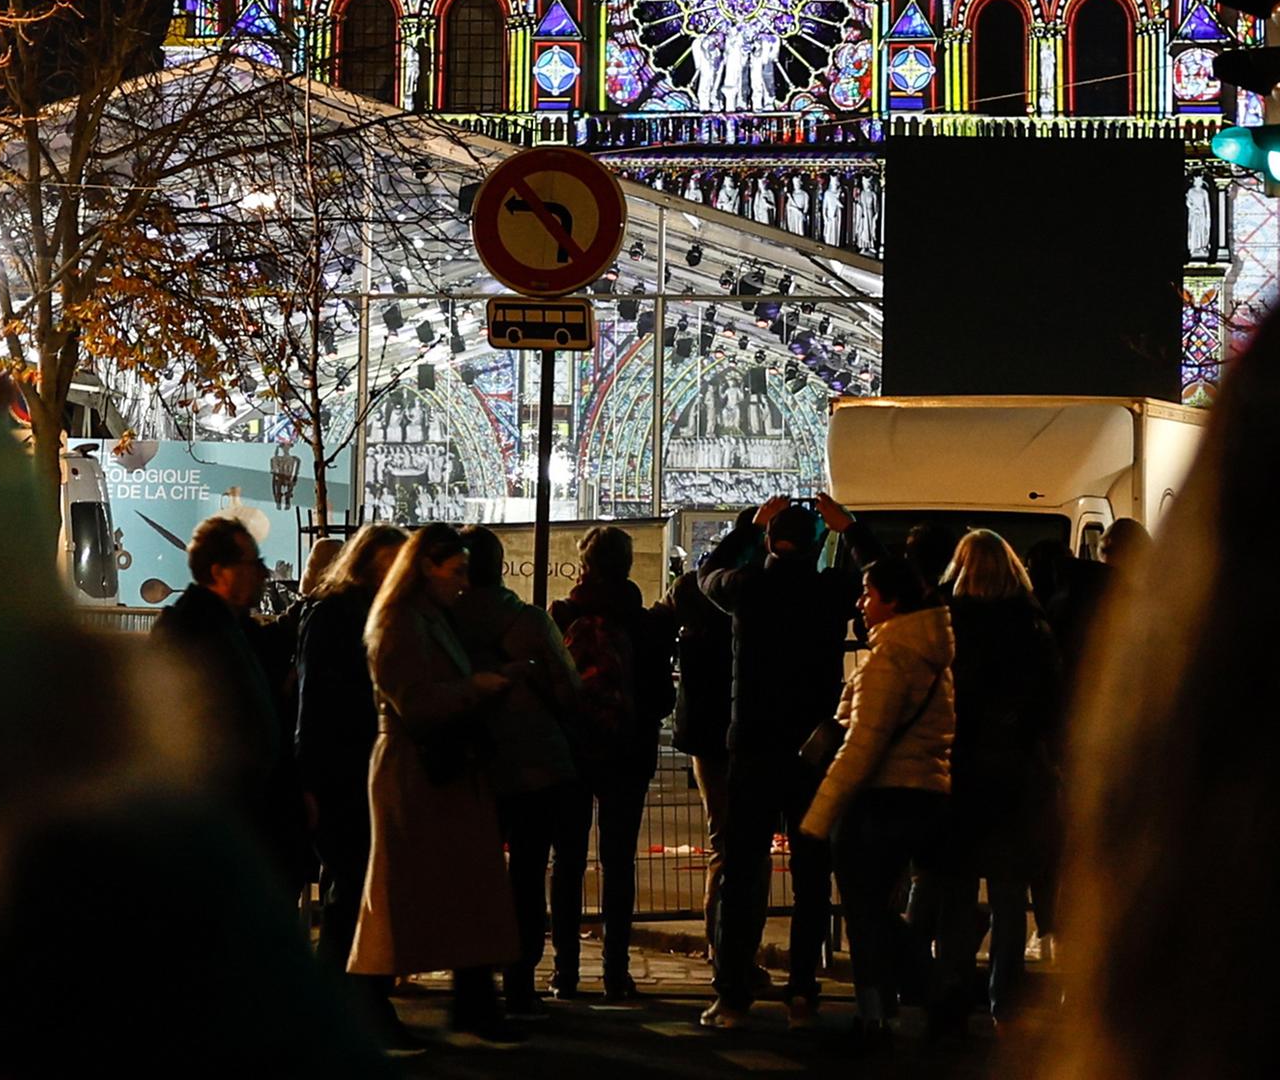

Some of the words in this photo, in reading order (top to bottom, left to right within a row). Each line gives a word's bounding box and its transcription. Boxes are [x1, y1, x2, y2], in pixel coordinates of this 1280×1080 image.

[117, 484, 142, 499] DE
[145, 485, 167, 500] LA
[170, 483, 210, 500] CITÉ
